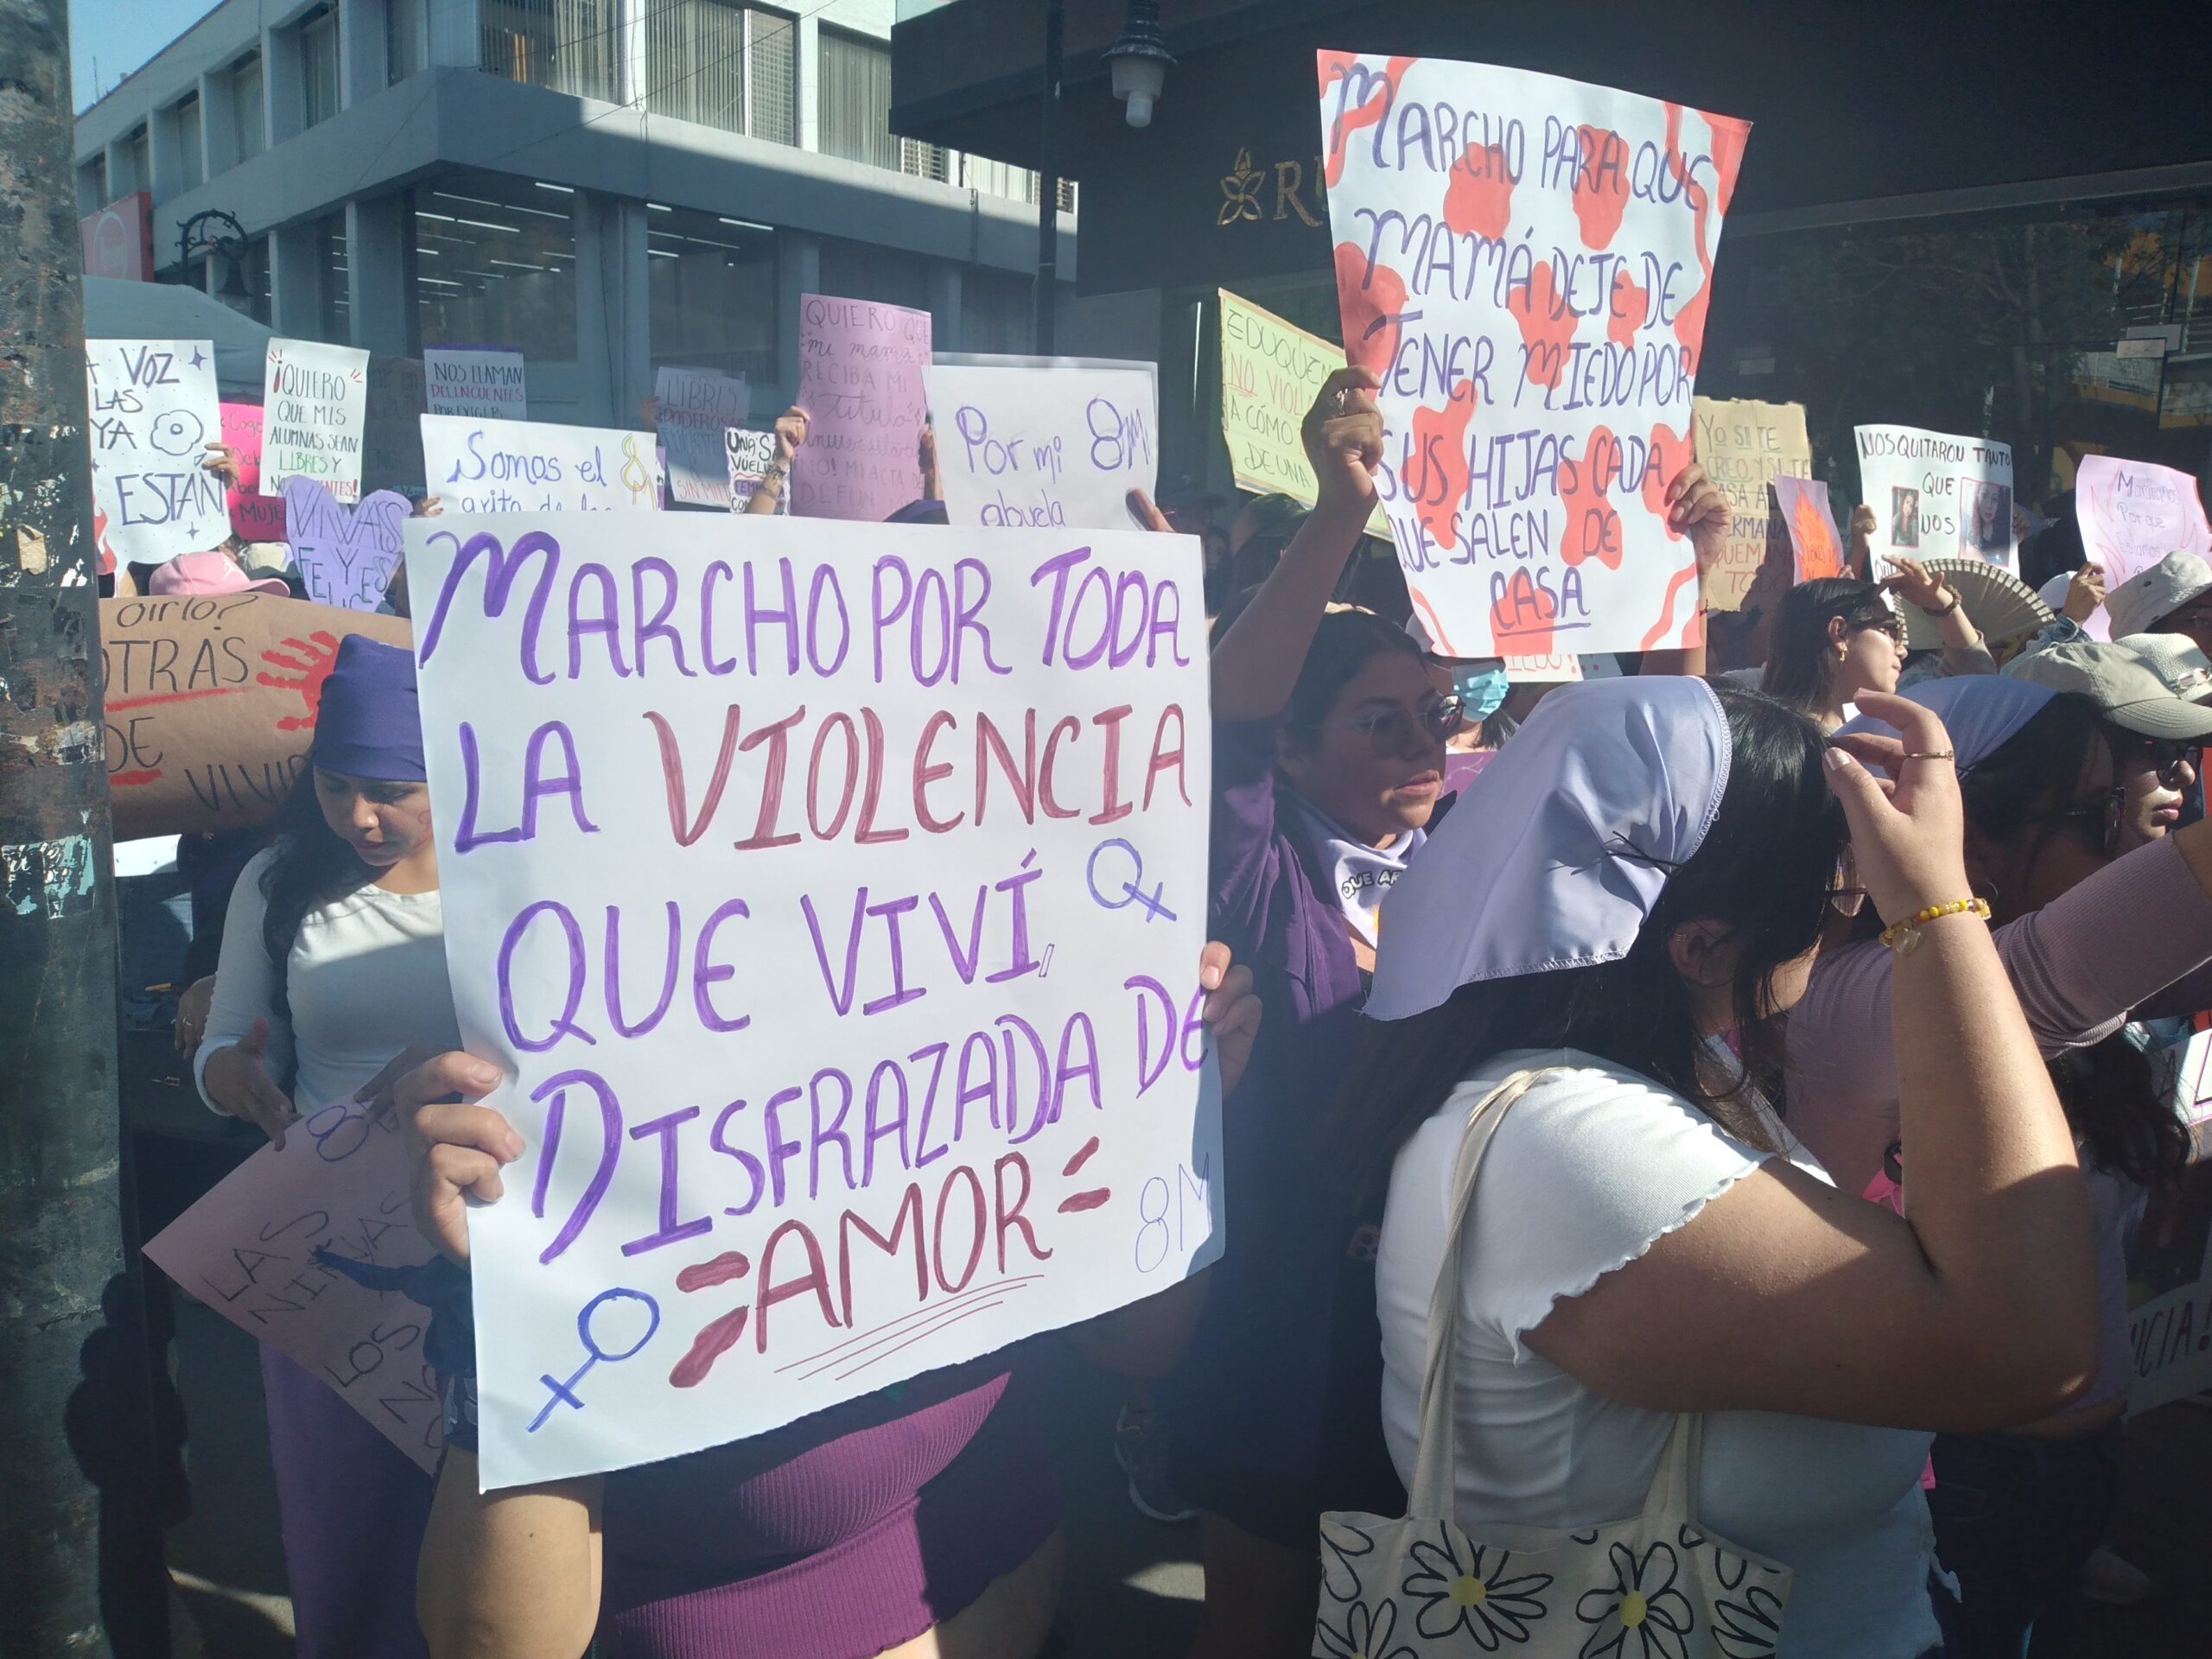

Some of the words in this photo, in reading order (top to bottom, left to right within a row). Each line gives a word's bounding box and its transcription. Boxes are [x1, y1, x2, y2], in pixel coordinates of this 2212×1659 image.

[1331, 62, 1525, 185] MARCHO
[1541, 114, 1621, 195] PARA
[1631, 140, 1713, 211] QUE
[1274, 154, 1325, 227] R
[1354, 207, 1535, 311] MAMÁ
[1550, 245, 1627, 321] DEJE
[1640, 251, 1683, 330] DE
[806, 300, 896, 333] QUIERO
[904, 316, 930, 346] QUE
[120, 346, 180, 386] VOZ
[435, 362, 467, 384] NOS
[472, 364, 523, 386] LLAMAN
[803, 359, 876, 391] RECIBA
[887, 371, 906, 393] MI
[1230, 353, 1256, 394] NO
[1363, 308, 1495, 406] TENER
[1513, 337, 1638, 411] MIEDO
[1636, 342, 1694, 409] POR
[94, 389, 143, 413] LAS
[277, 399, 304, 425] QUE
[314, 405, 346, 426] MIS
[430, 384, 524, 403] DELINCUENTES
[90, 418, 137, 449] YA
[269, 426, 324, 450] ALUMNAS
[327, 434, 358, 454] SEAN
[1086, 397, 1150, 471] 8M
[1230, 395, 1240, 422] A
[1246, 404, 1294, 446] CÓMO
[1757, 426, 1780, 451] TE
[279, 448, 327, 474] LIBRES
[332, 457, 341, 473] Y
[447, 429, 563, 486] Somos
[575, 446, 607, 486] el
[727, 432, 756, 458] UNA
[955, 406, 1024, 476] Por
[1033, 435, 1062, 485] mi
[1244, 442, 1274, 474] DE
[1276, 454, 1311, 488] UNA
[1859, 431, 1895, 460] NOS
[1897, 434, 1965, 464] QUITARON
[1973, 447, 2012, 470] TANTO
[677, 480, 699, 499] SIN
[844, 461, 864, 479] MI
[869, 464, 905, 491] ACTA
[1464, 429, 1580, 512] HIJAS
[1591, 434, 1665, 496] CADA
[1706, 456, 1749, 481] CREO
[1922, 471, 1955, 496] QUE
[284, 481, 404, 555] VIVAS
[1450, 508, 1550, 566] SALEN
[1581, 509, 1618, 557] DE
[1921, 514, 1955, 536] NOS
[418, 531, 851, 685] MARCHO
[873, 554, 1014, 687] POR
[1031, 546, 1191, 671] TODA
[1489, 565, 1592, 631] CASA
[454, 720, 601, 853] LA
[642, 702, 1193, 851] VIOLENCIA
[1341, 872, 1374, 899] QUE
[496, 899, 752, 1054] QUE
[529, 1013, 1103, 1266] DISFRAZADA
[1123, 974, 1209, 1099] DE
[1135, 1152, 1211, 1274] 8M
[754, 1150, 1054, 1354] AMOR
